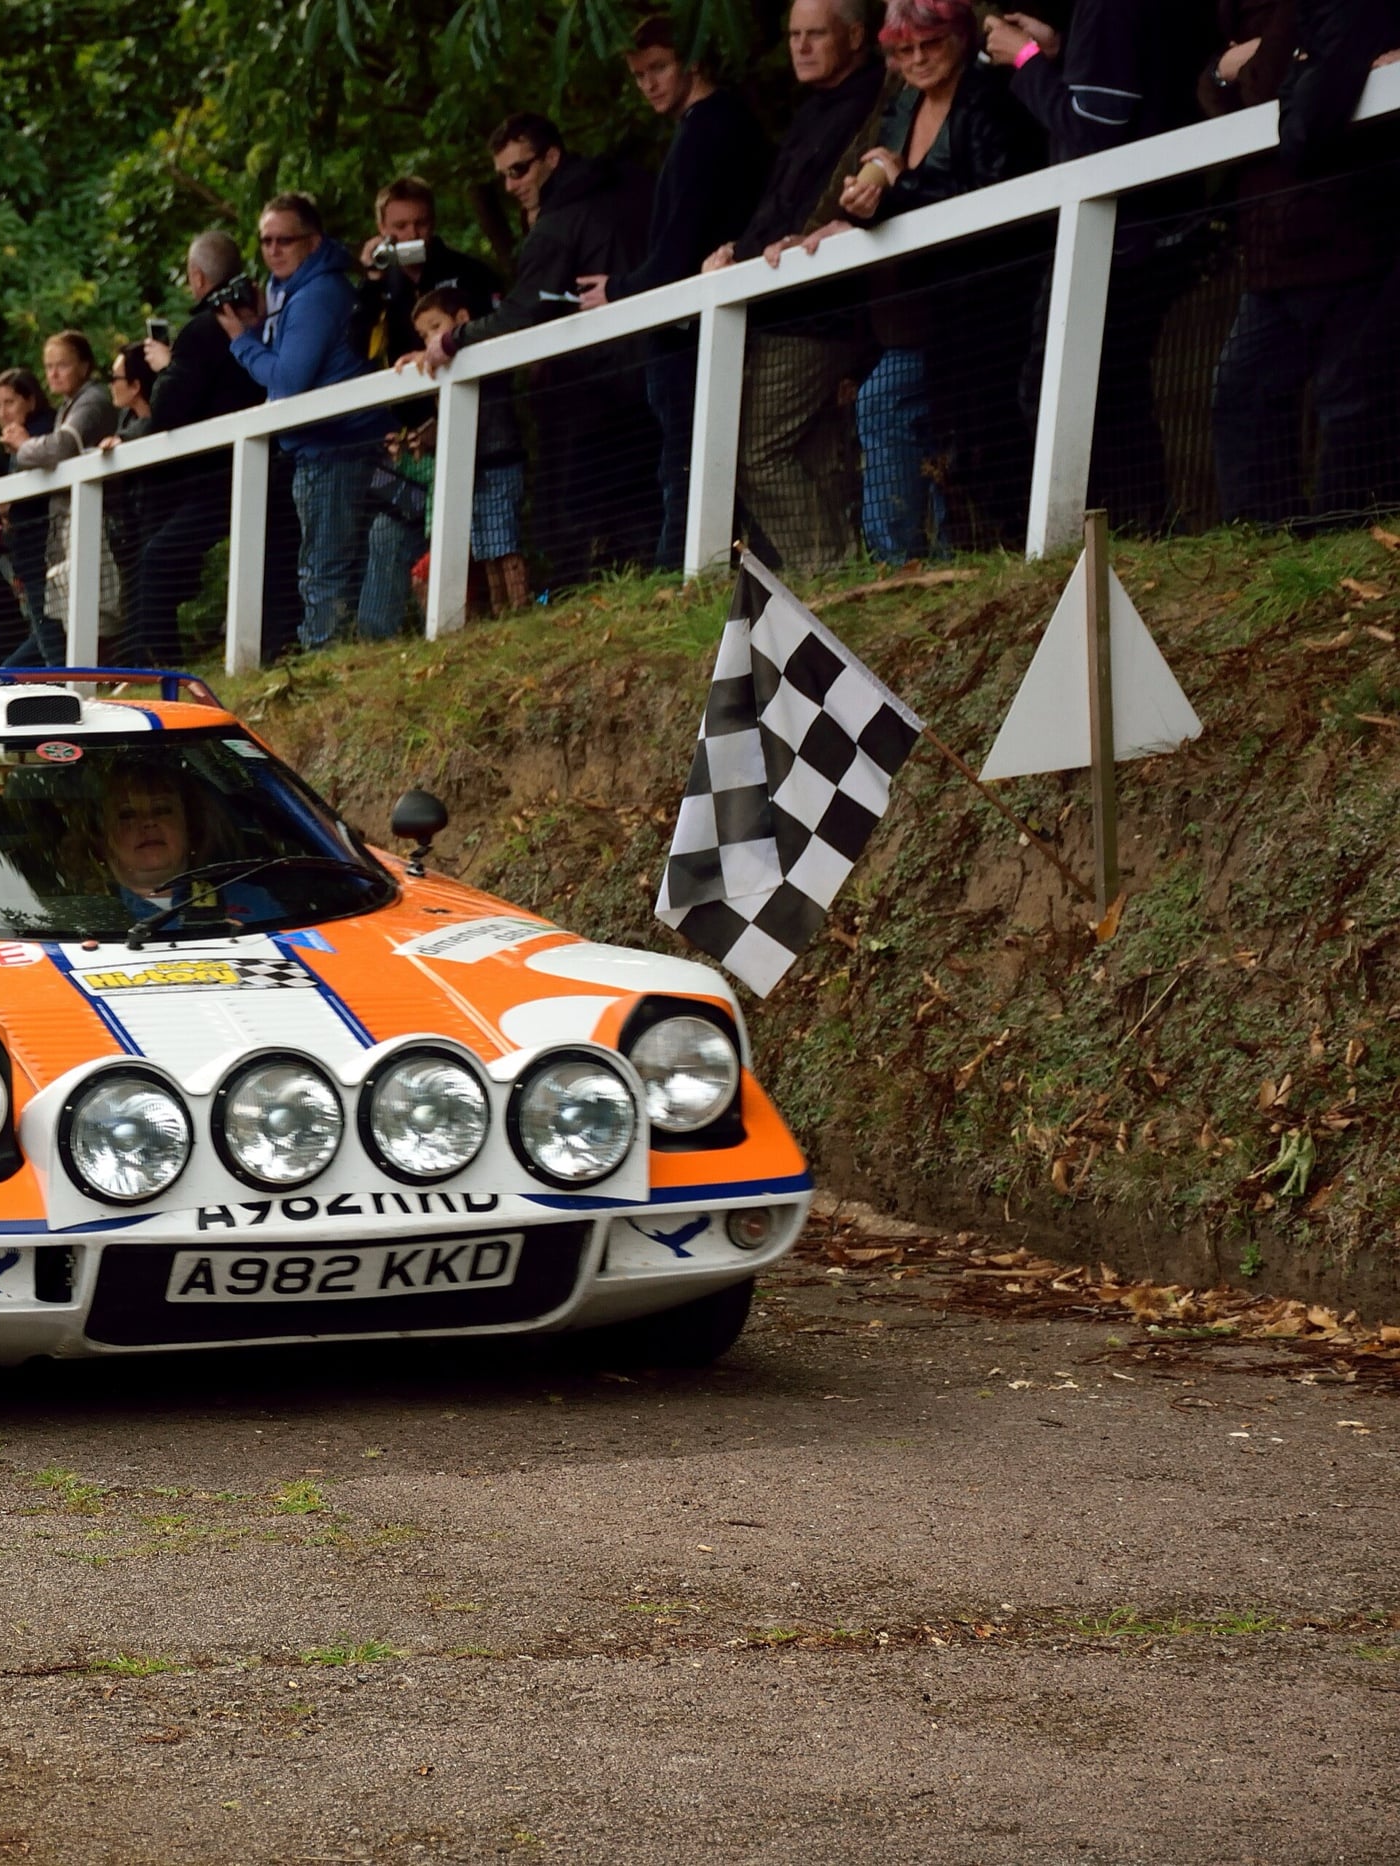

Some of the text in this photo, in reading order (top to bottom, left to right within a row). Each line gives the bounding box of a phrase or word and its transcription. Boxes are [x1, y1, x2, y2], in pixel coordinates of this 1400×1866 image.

[83, 968, 239, 990] History
[177, 1240, 512, 1296] A982 KKD
